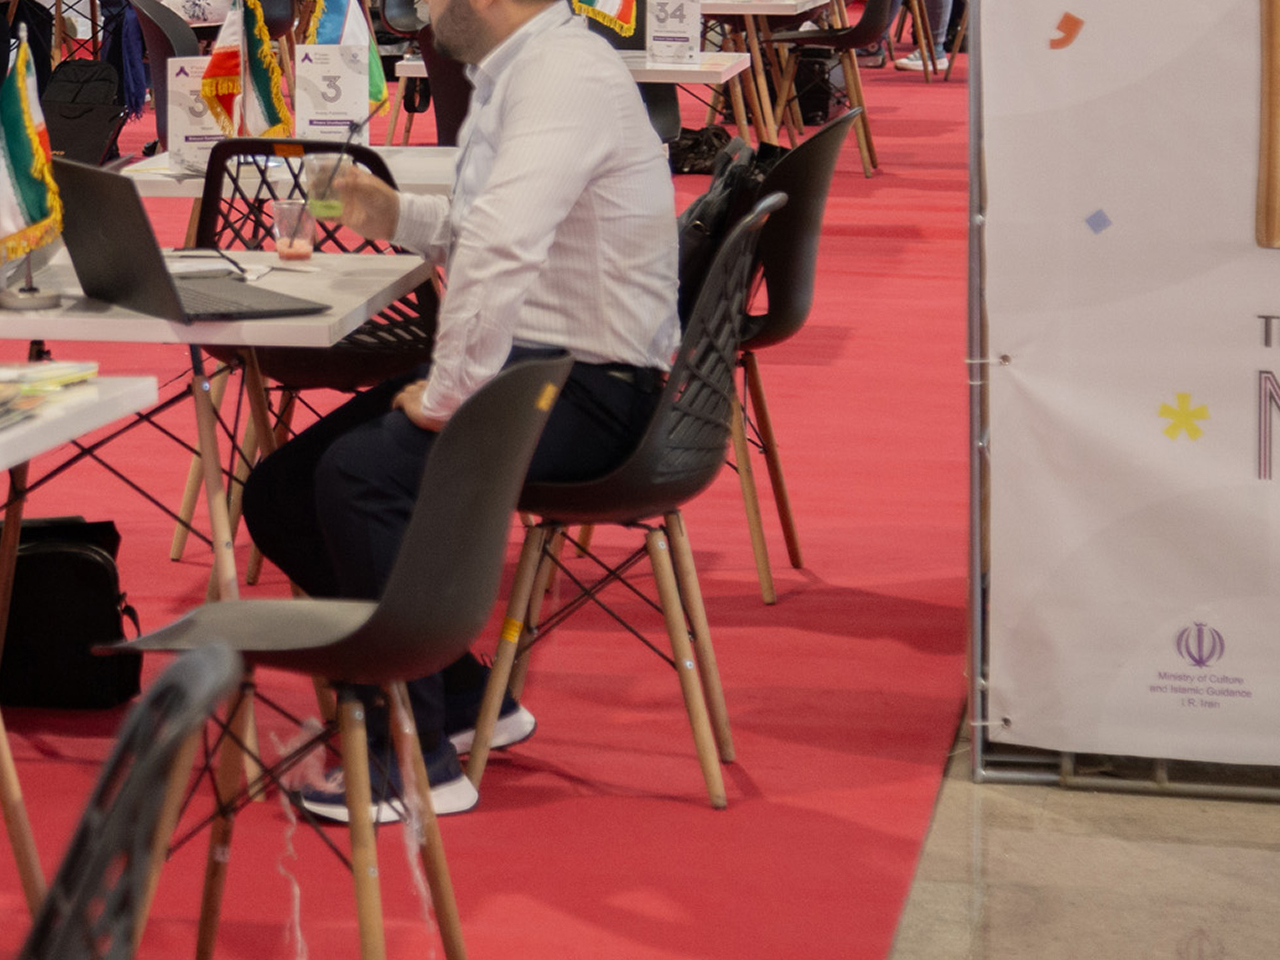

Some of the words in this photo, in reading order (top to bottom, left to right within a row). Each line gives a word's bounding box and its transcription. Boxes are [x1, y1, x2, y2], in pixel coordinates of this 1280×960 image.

[655, 2, 686, 24] 34
[321, 75, 342, 103] 3
[1158, 671, 1195, 684] Ministry
[1197, 675, 1207, 683] of
[1208, 675, 1245, 686] Culture
[1149, 685, 1168, 693] and
[1170, 685, 1204, 695] Islamic
[1206, 687, 1253, 699] Guidance
